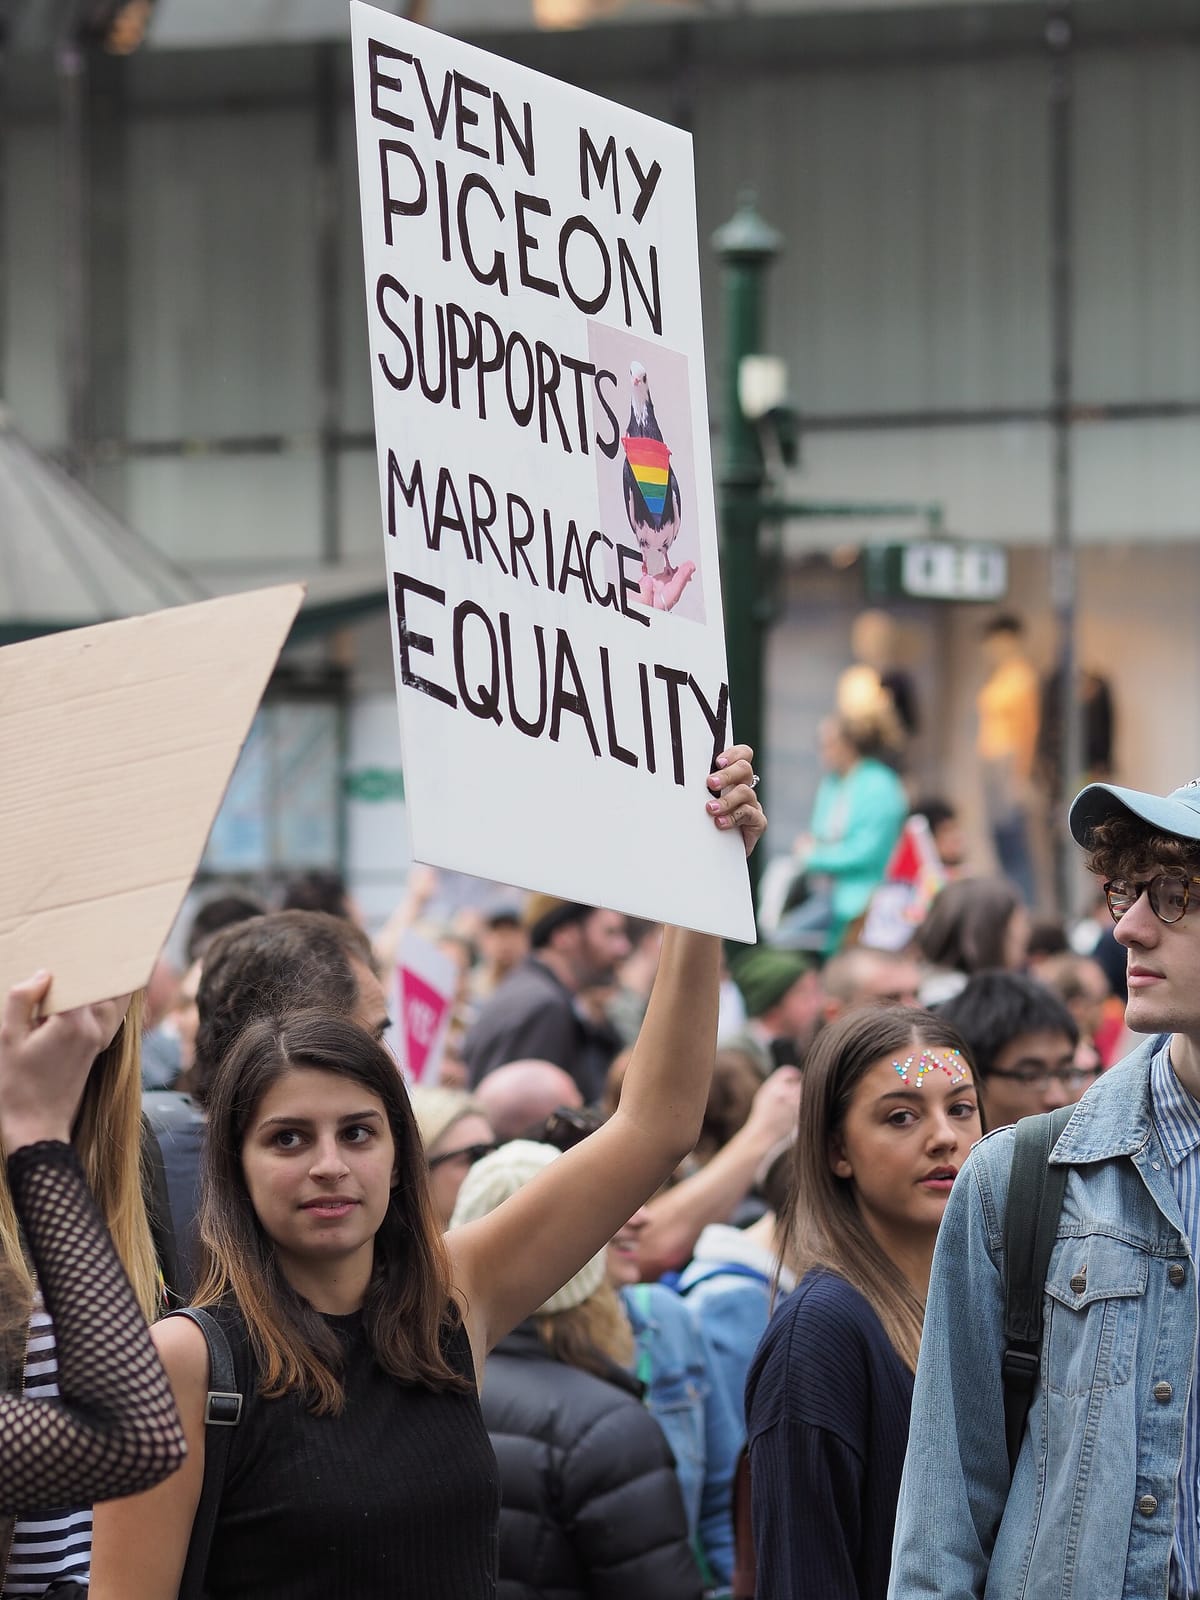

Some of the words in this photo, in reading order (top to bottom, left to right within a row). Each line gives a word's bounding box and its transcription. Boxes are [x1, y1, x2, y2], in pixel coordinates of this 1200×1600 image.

[368, 38, 535, 176] EVEN
[580, 126, 662, 224] MY
[379, 138, 663, 336] PIGEON
[376, 273, 620, 459] SUPPORTS
[387, 448, 651, 627] MARRIAGE
[394, 572, 729, 799] EQUALITY
